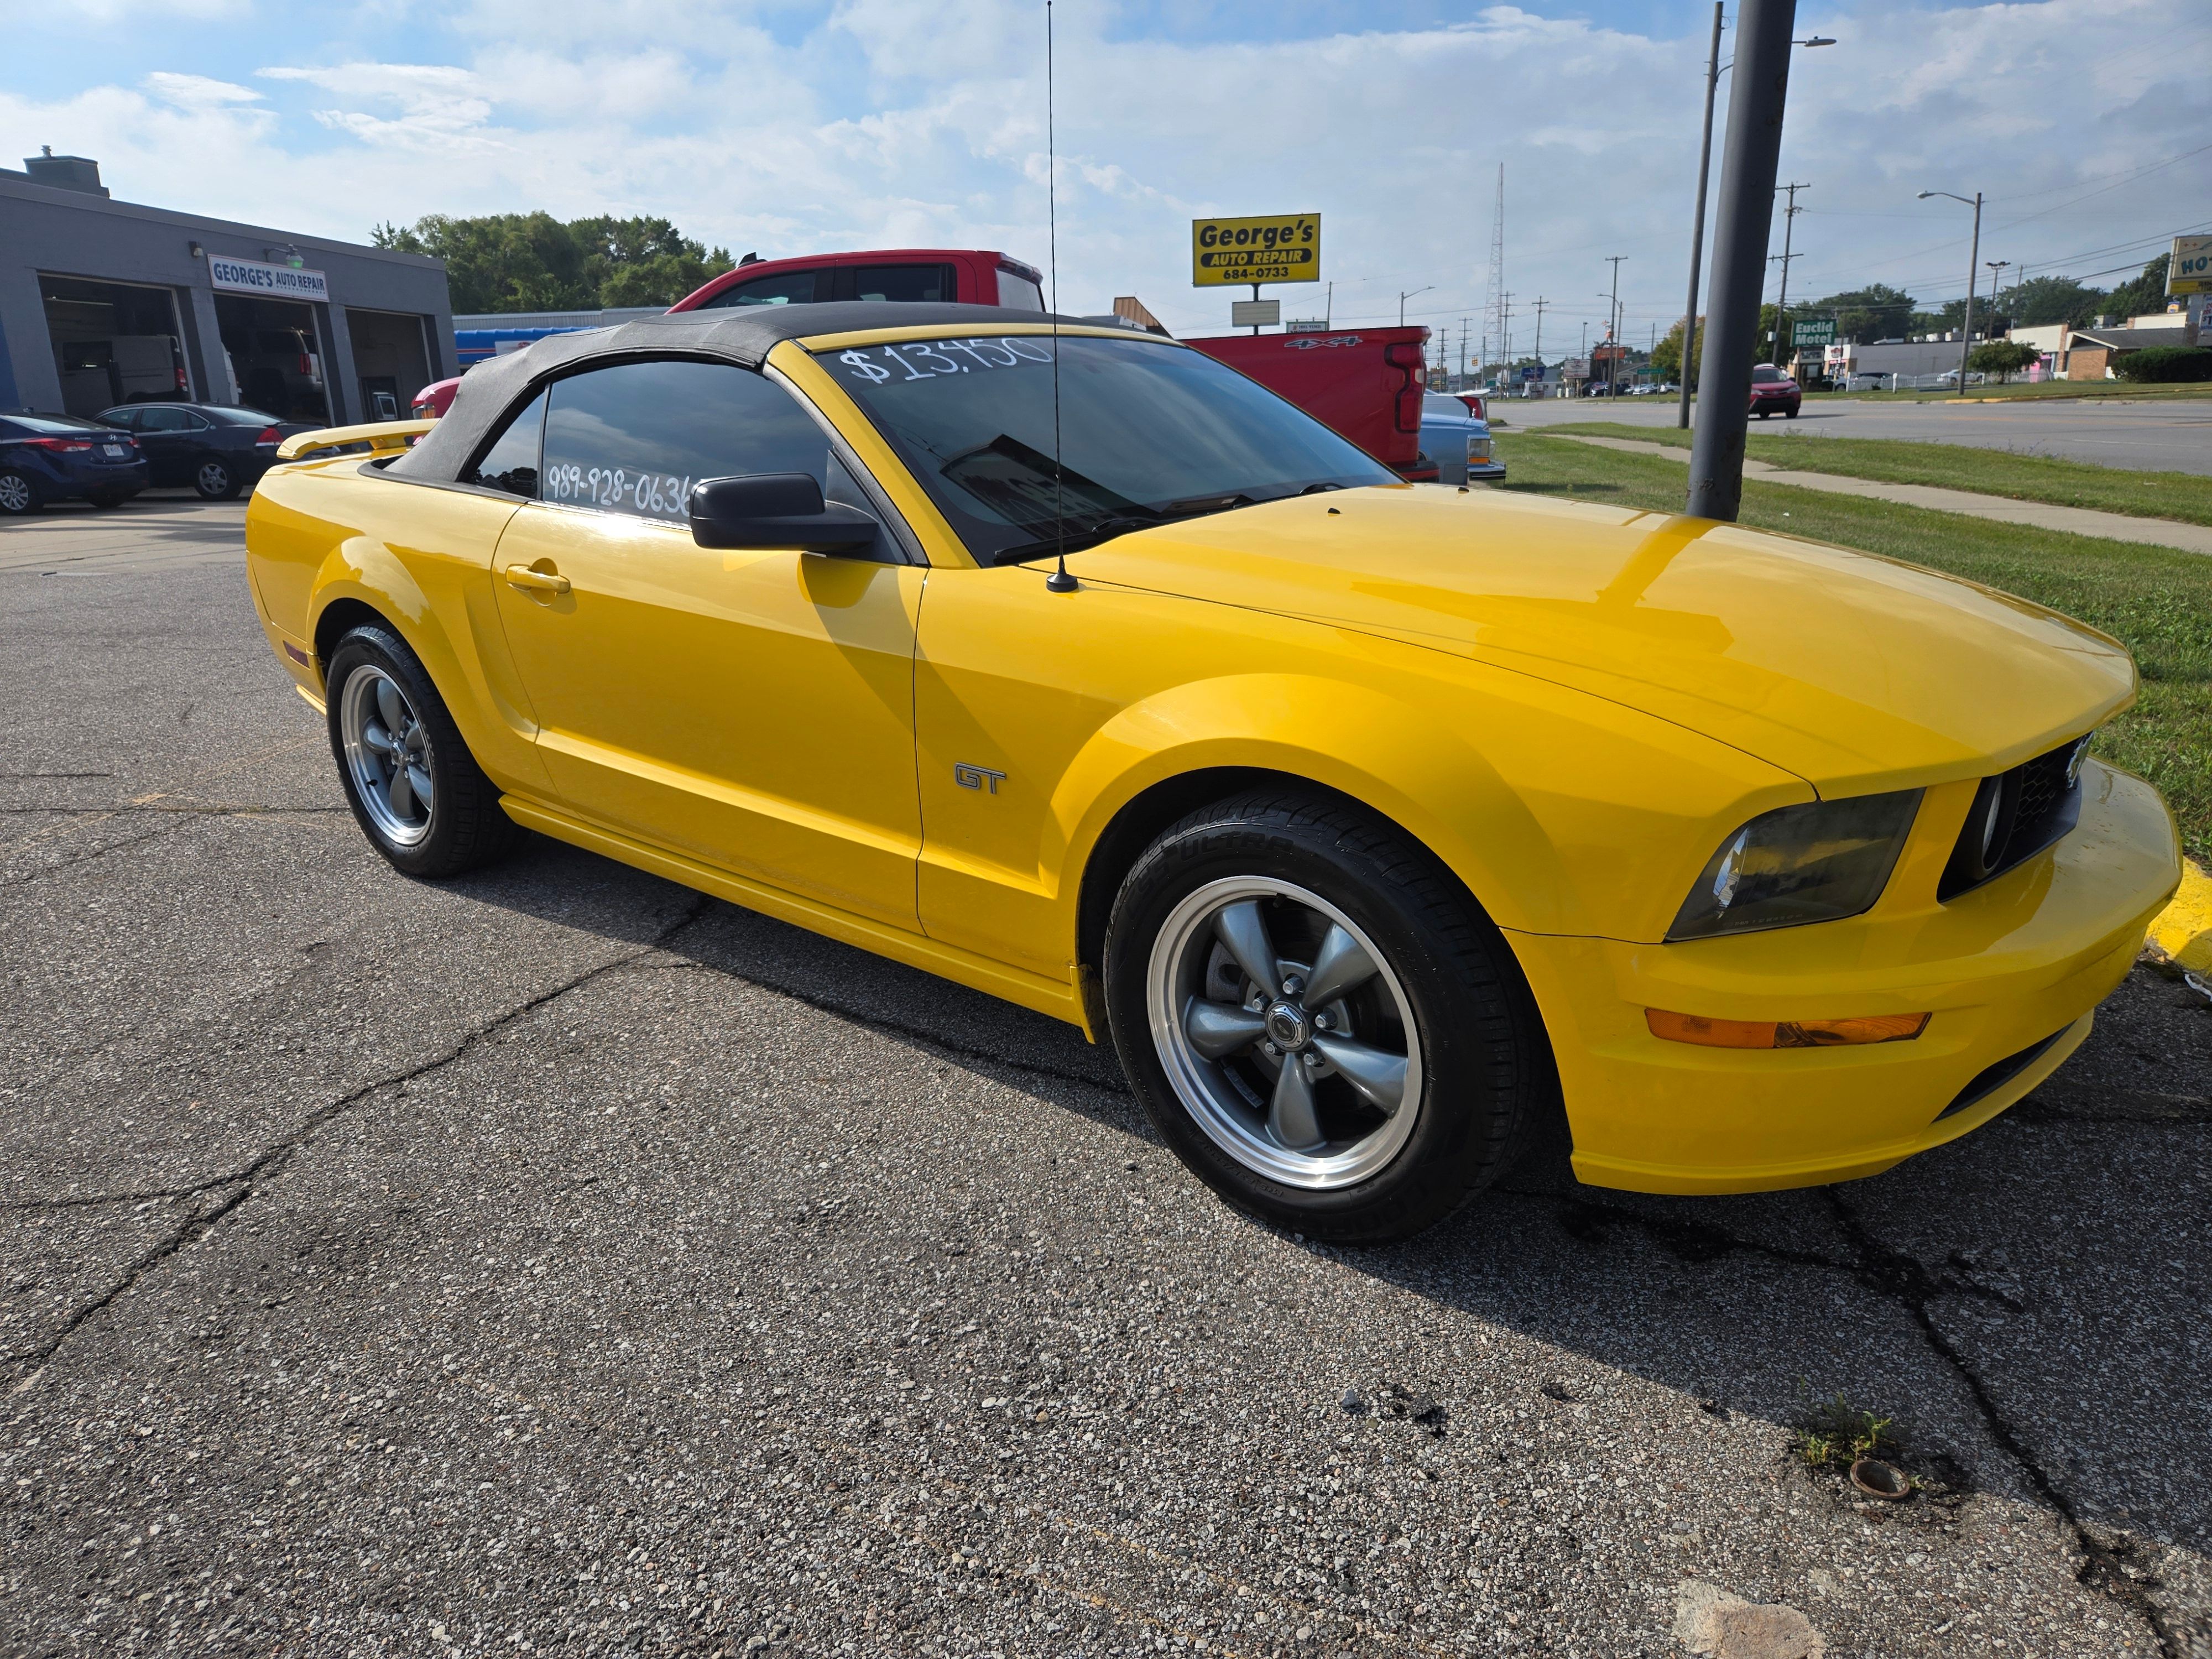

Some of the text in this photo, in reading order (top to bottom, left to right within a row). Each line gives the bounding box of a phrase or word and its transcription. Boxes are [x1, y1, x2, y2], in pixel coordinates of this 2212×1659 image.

[1199, 220, 1313, 249] George's
[1210, 251, 1303, 266] AUTO REPAIR
[2181, 256, 2212, 275] HO
[213, 262, 325, 291] GEORGE'S AUTO REPAIR
[1223, 267, 1288, 279] 684-0733
[1796, 321, 1834, 333] Euclid
[1795, 333, 1832, 345] Motel
[954, 762, 1006, 795] GT
[1180, 831, 1294, 862] ULTRA
